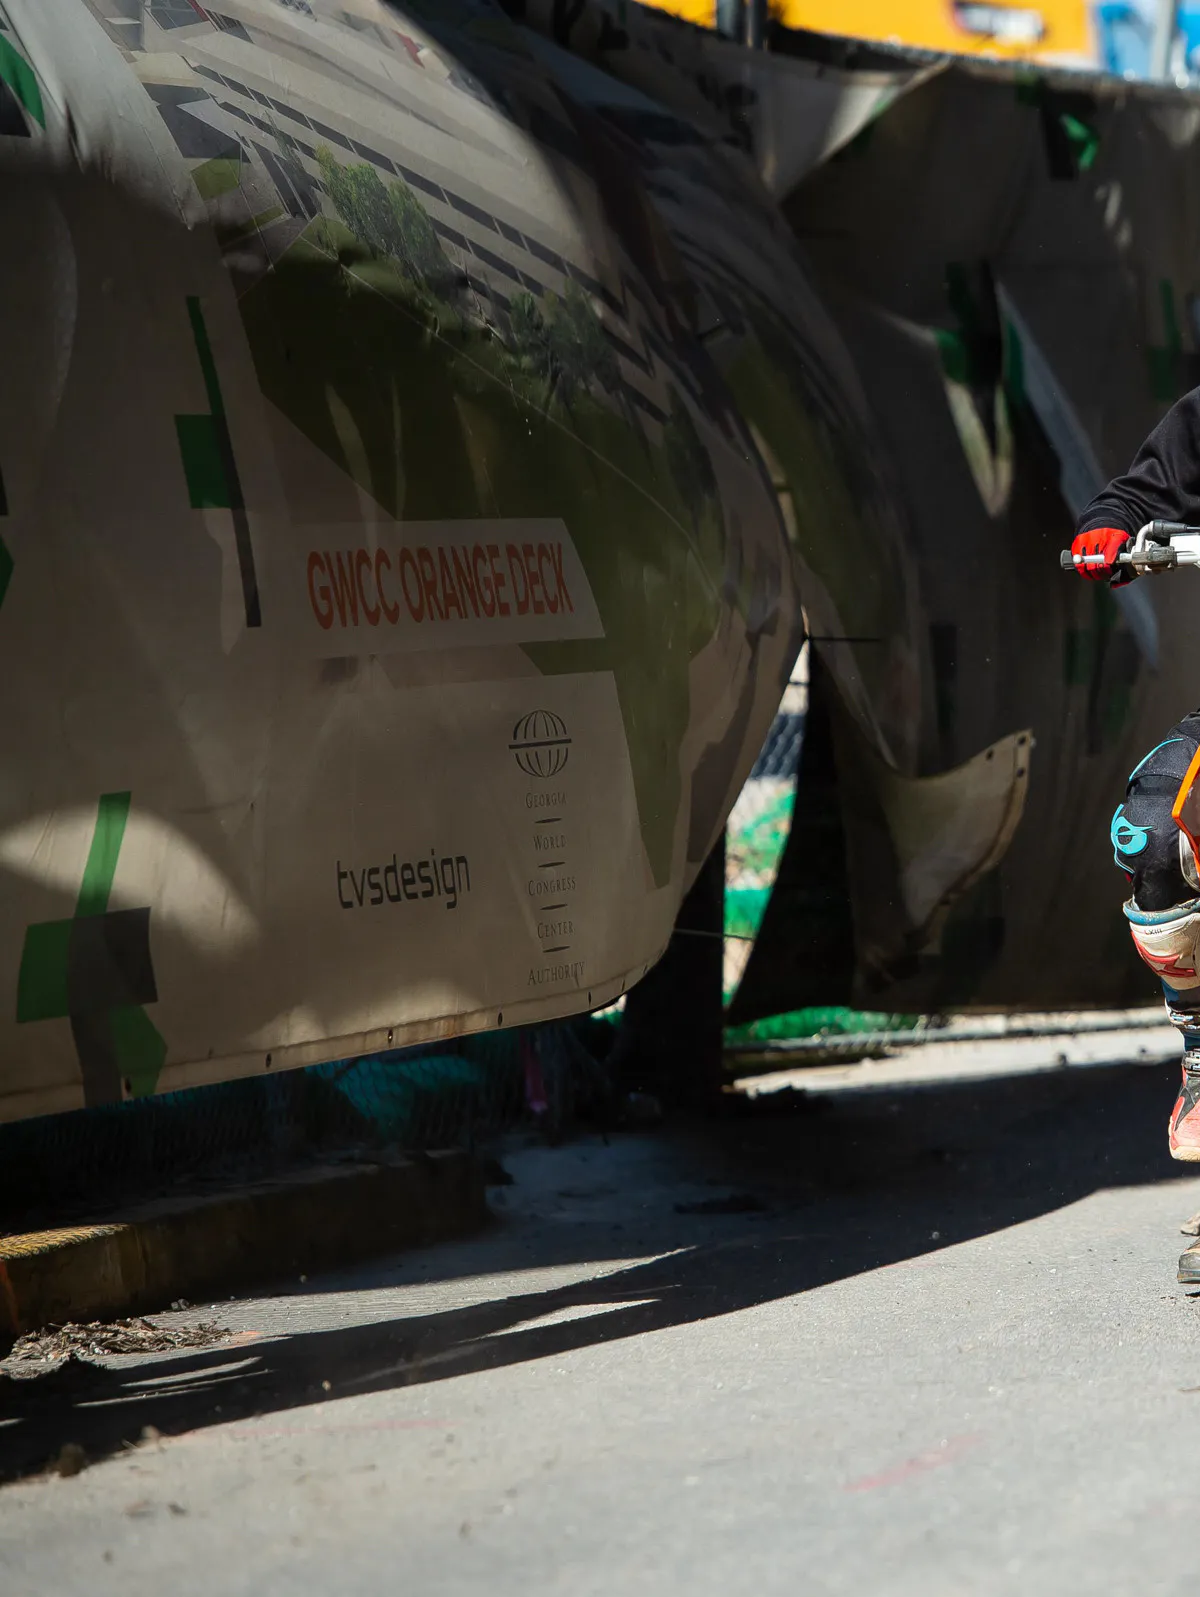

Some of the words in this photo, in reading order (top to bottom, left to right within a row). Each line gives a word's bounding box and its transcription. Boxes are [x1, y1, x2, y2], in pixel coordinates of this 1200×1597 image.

[306, 547, 400, 630] GWCC
[400, 545, 511, 623] ORANGE
[505, 542, 574, 616] DECK
[336, 848, 471, 910] tvsdesign
